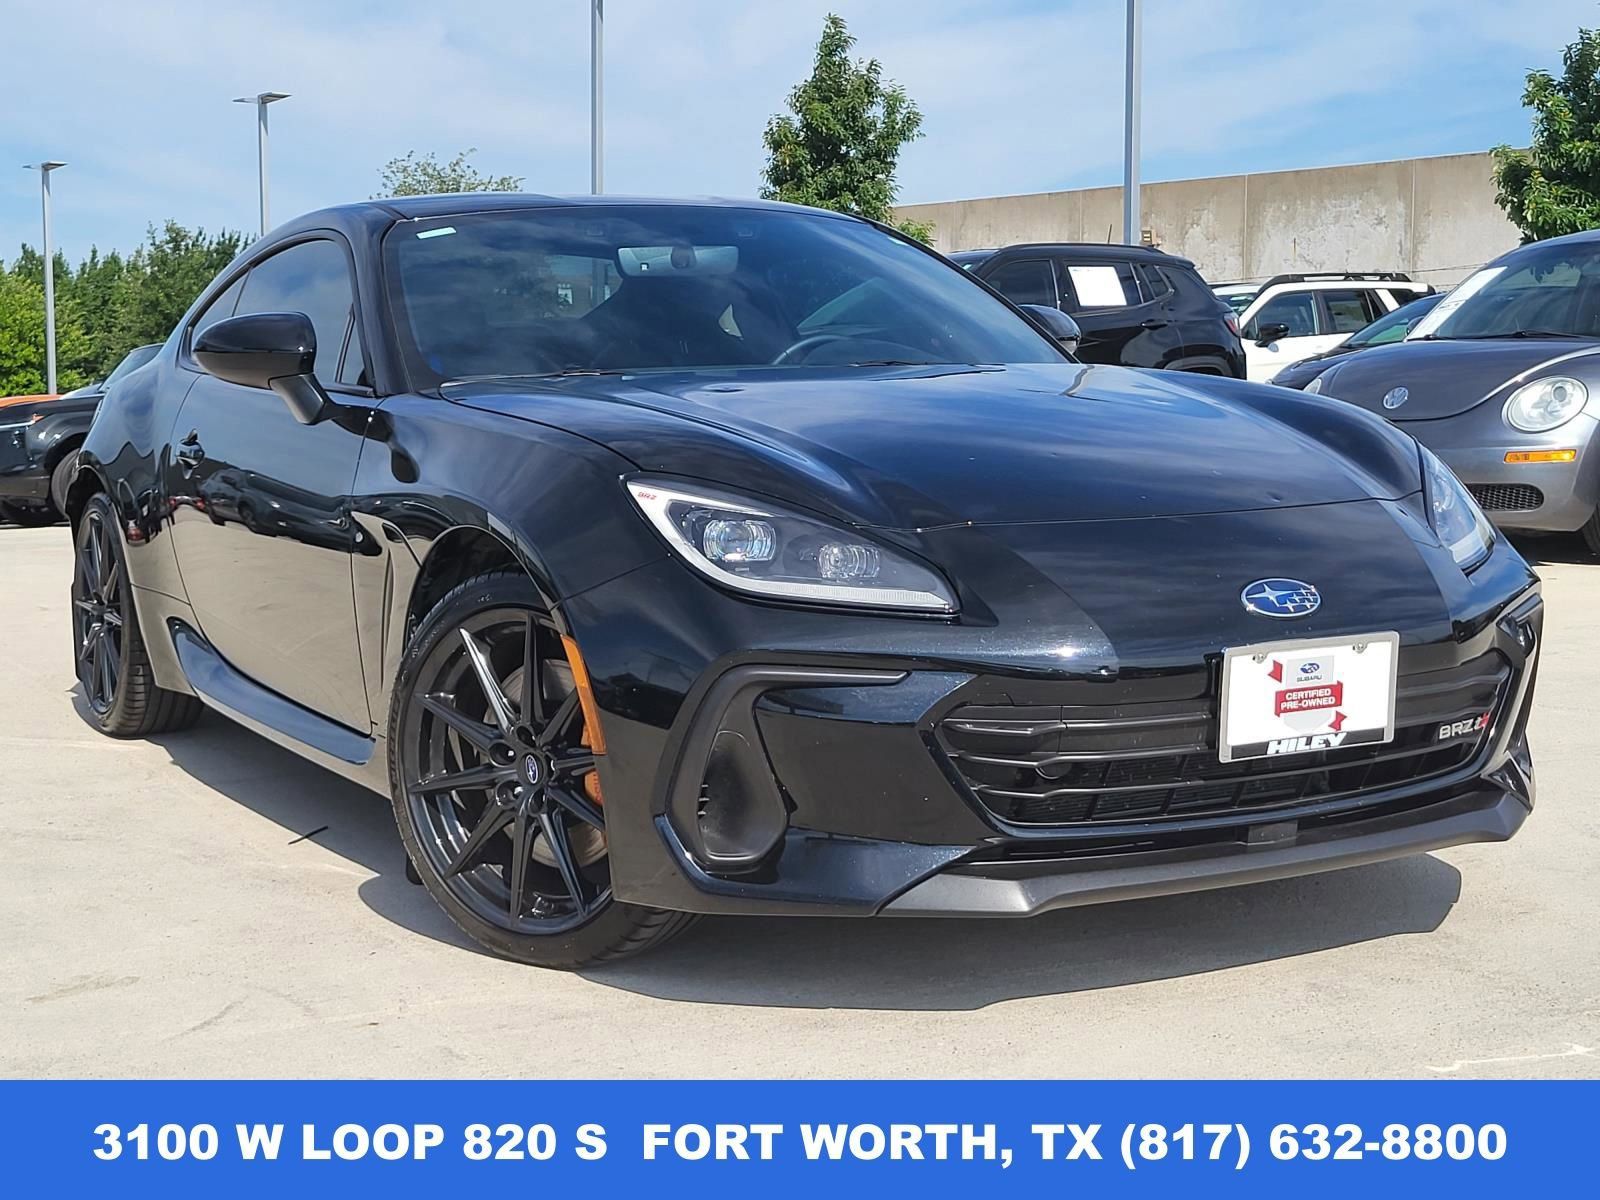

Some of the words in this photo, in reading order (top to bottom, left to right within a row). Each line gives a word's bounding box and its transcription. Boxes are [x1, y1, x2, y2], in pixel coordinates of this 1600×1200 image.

[1296, 674, 1323, 683] SUBARU
[1285, 688, 1332, 701] CERTIFIED
[1280, 696, 1336, 710] PRE-OWNED
[1439, 718, 1474, 739] BRZ
[1266, 731, 1347, 755] HILEY
